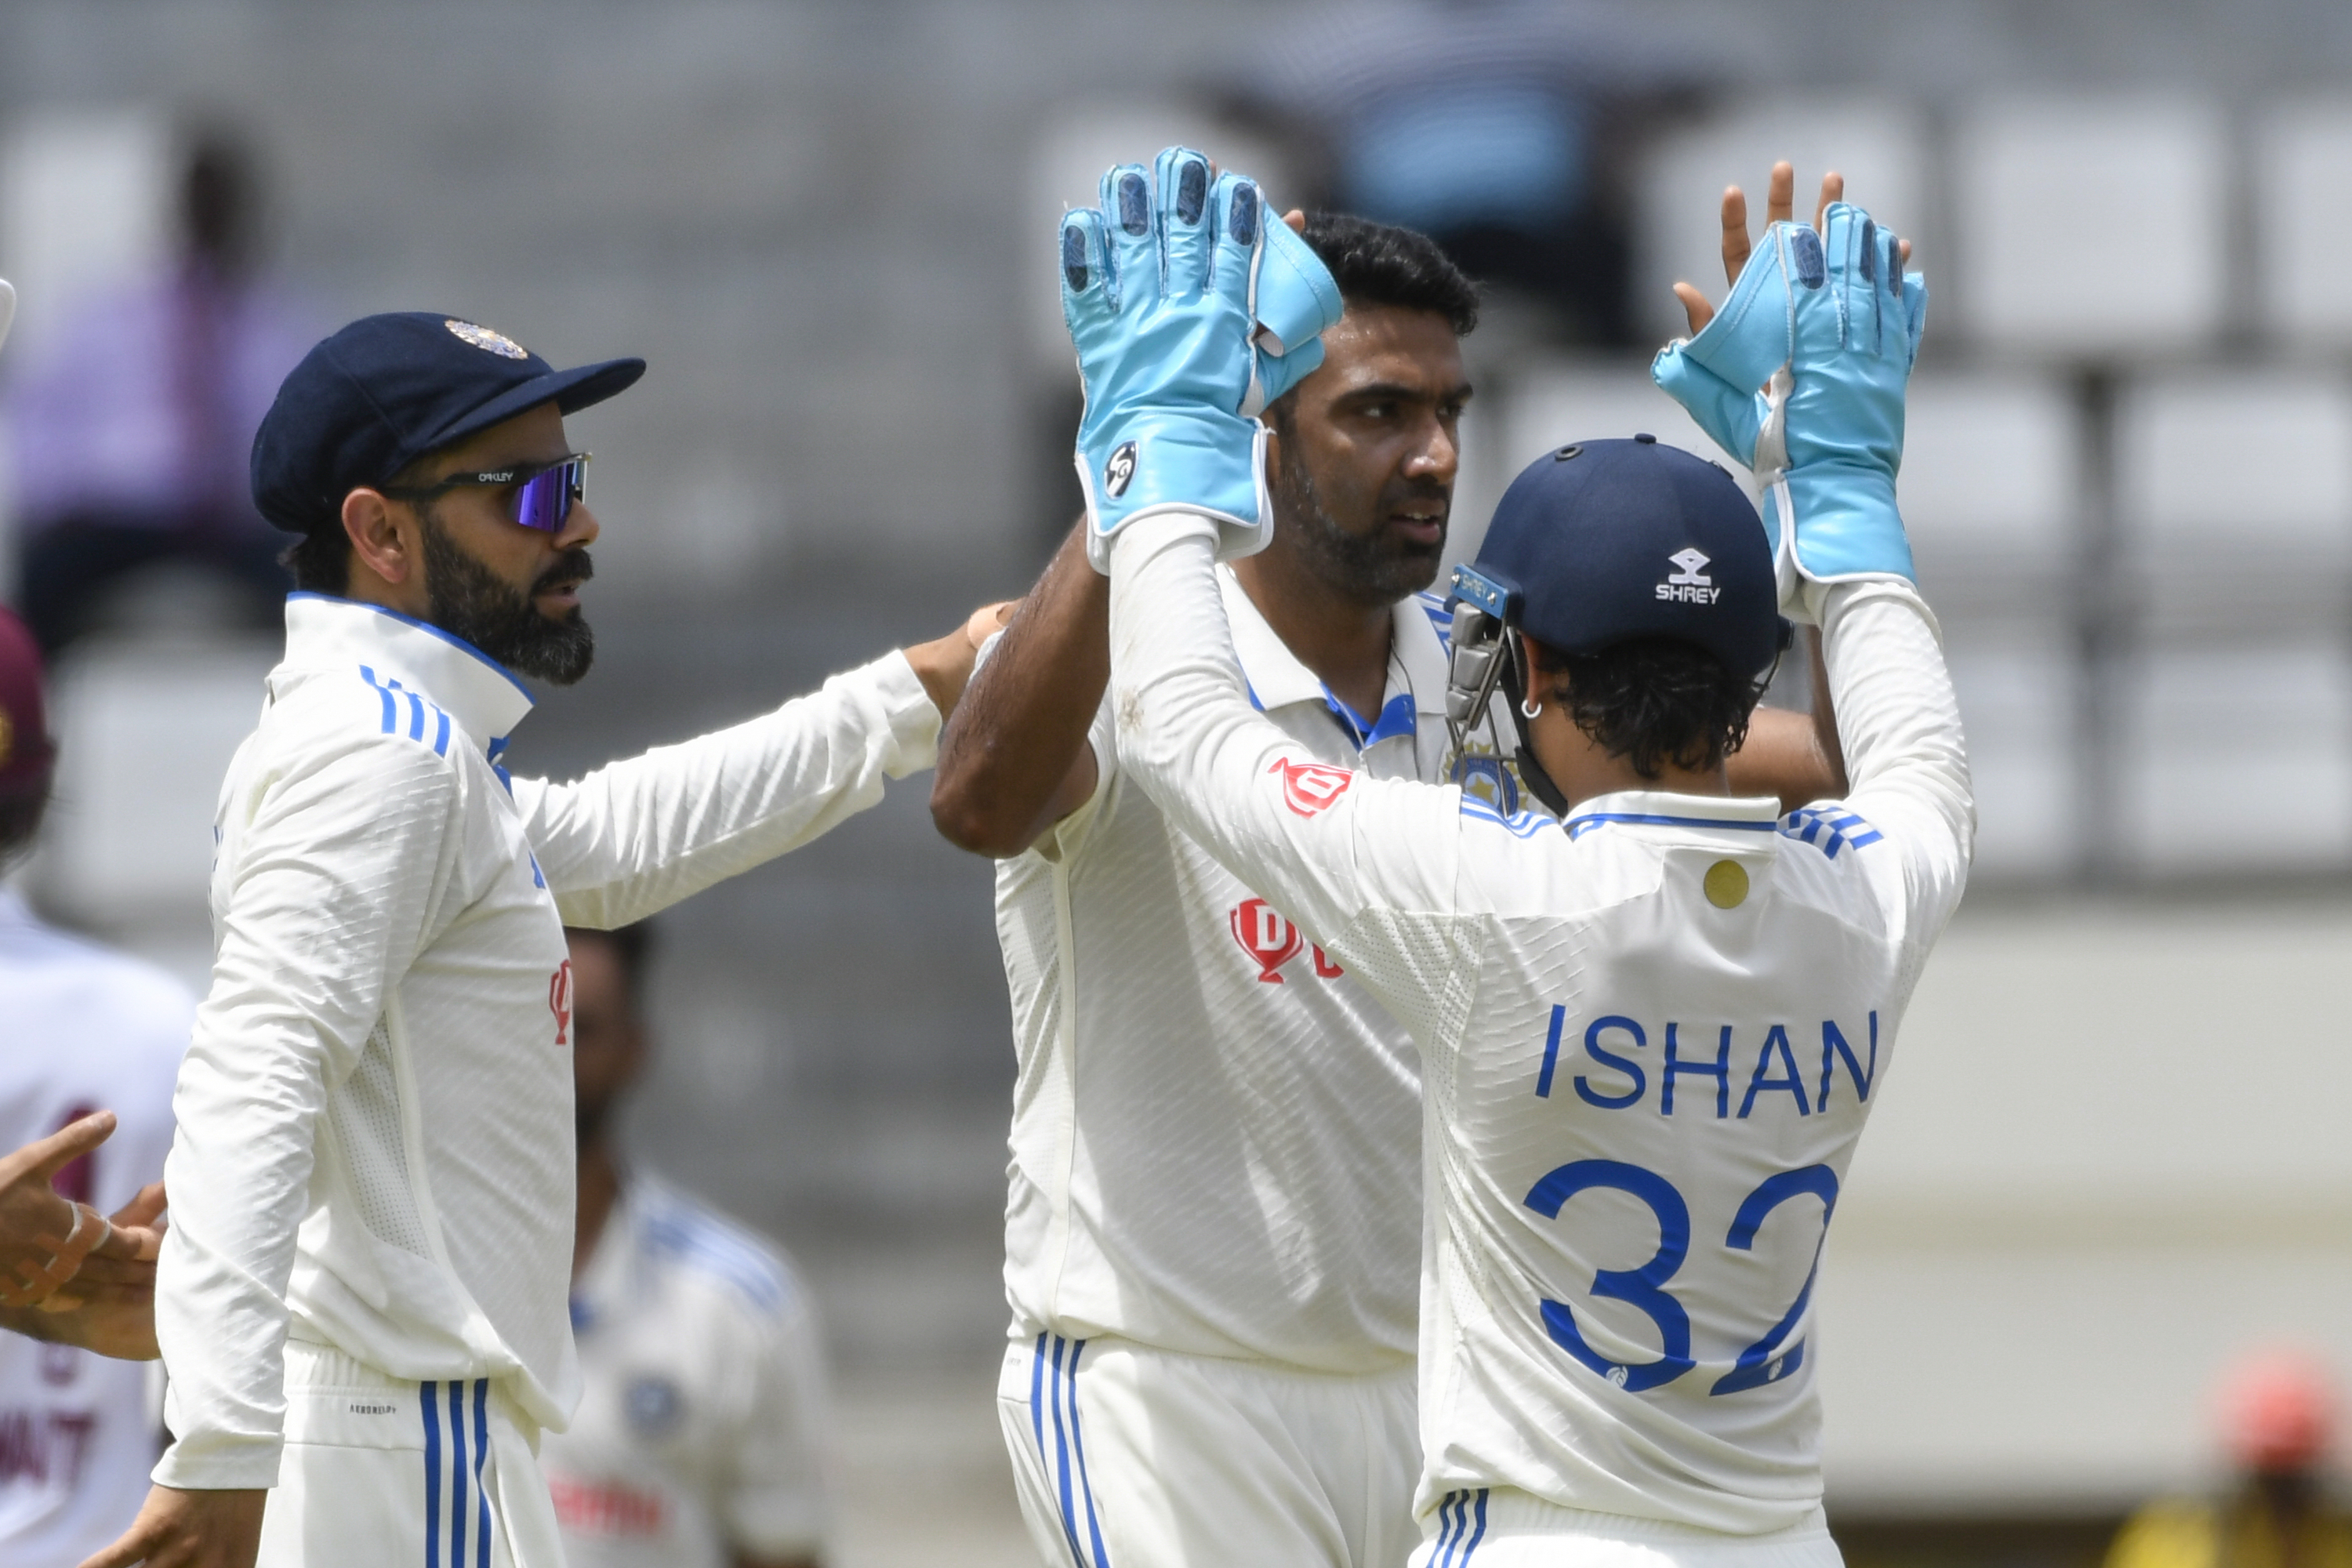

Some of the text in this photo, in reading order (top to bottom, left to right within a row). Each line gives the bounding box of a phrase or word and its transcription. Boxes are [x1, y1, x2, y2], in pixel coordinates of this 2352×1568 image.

[478, 473, 514, 482] OAKLEY
[1655, 584, 1721, 605] SHREY
[1535, 1004, 1878, 1119] ISHAN
[1523, 1159, 1839, 1396] 32
